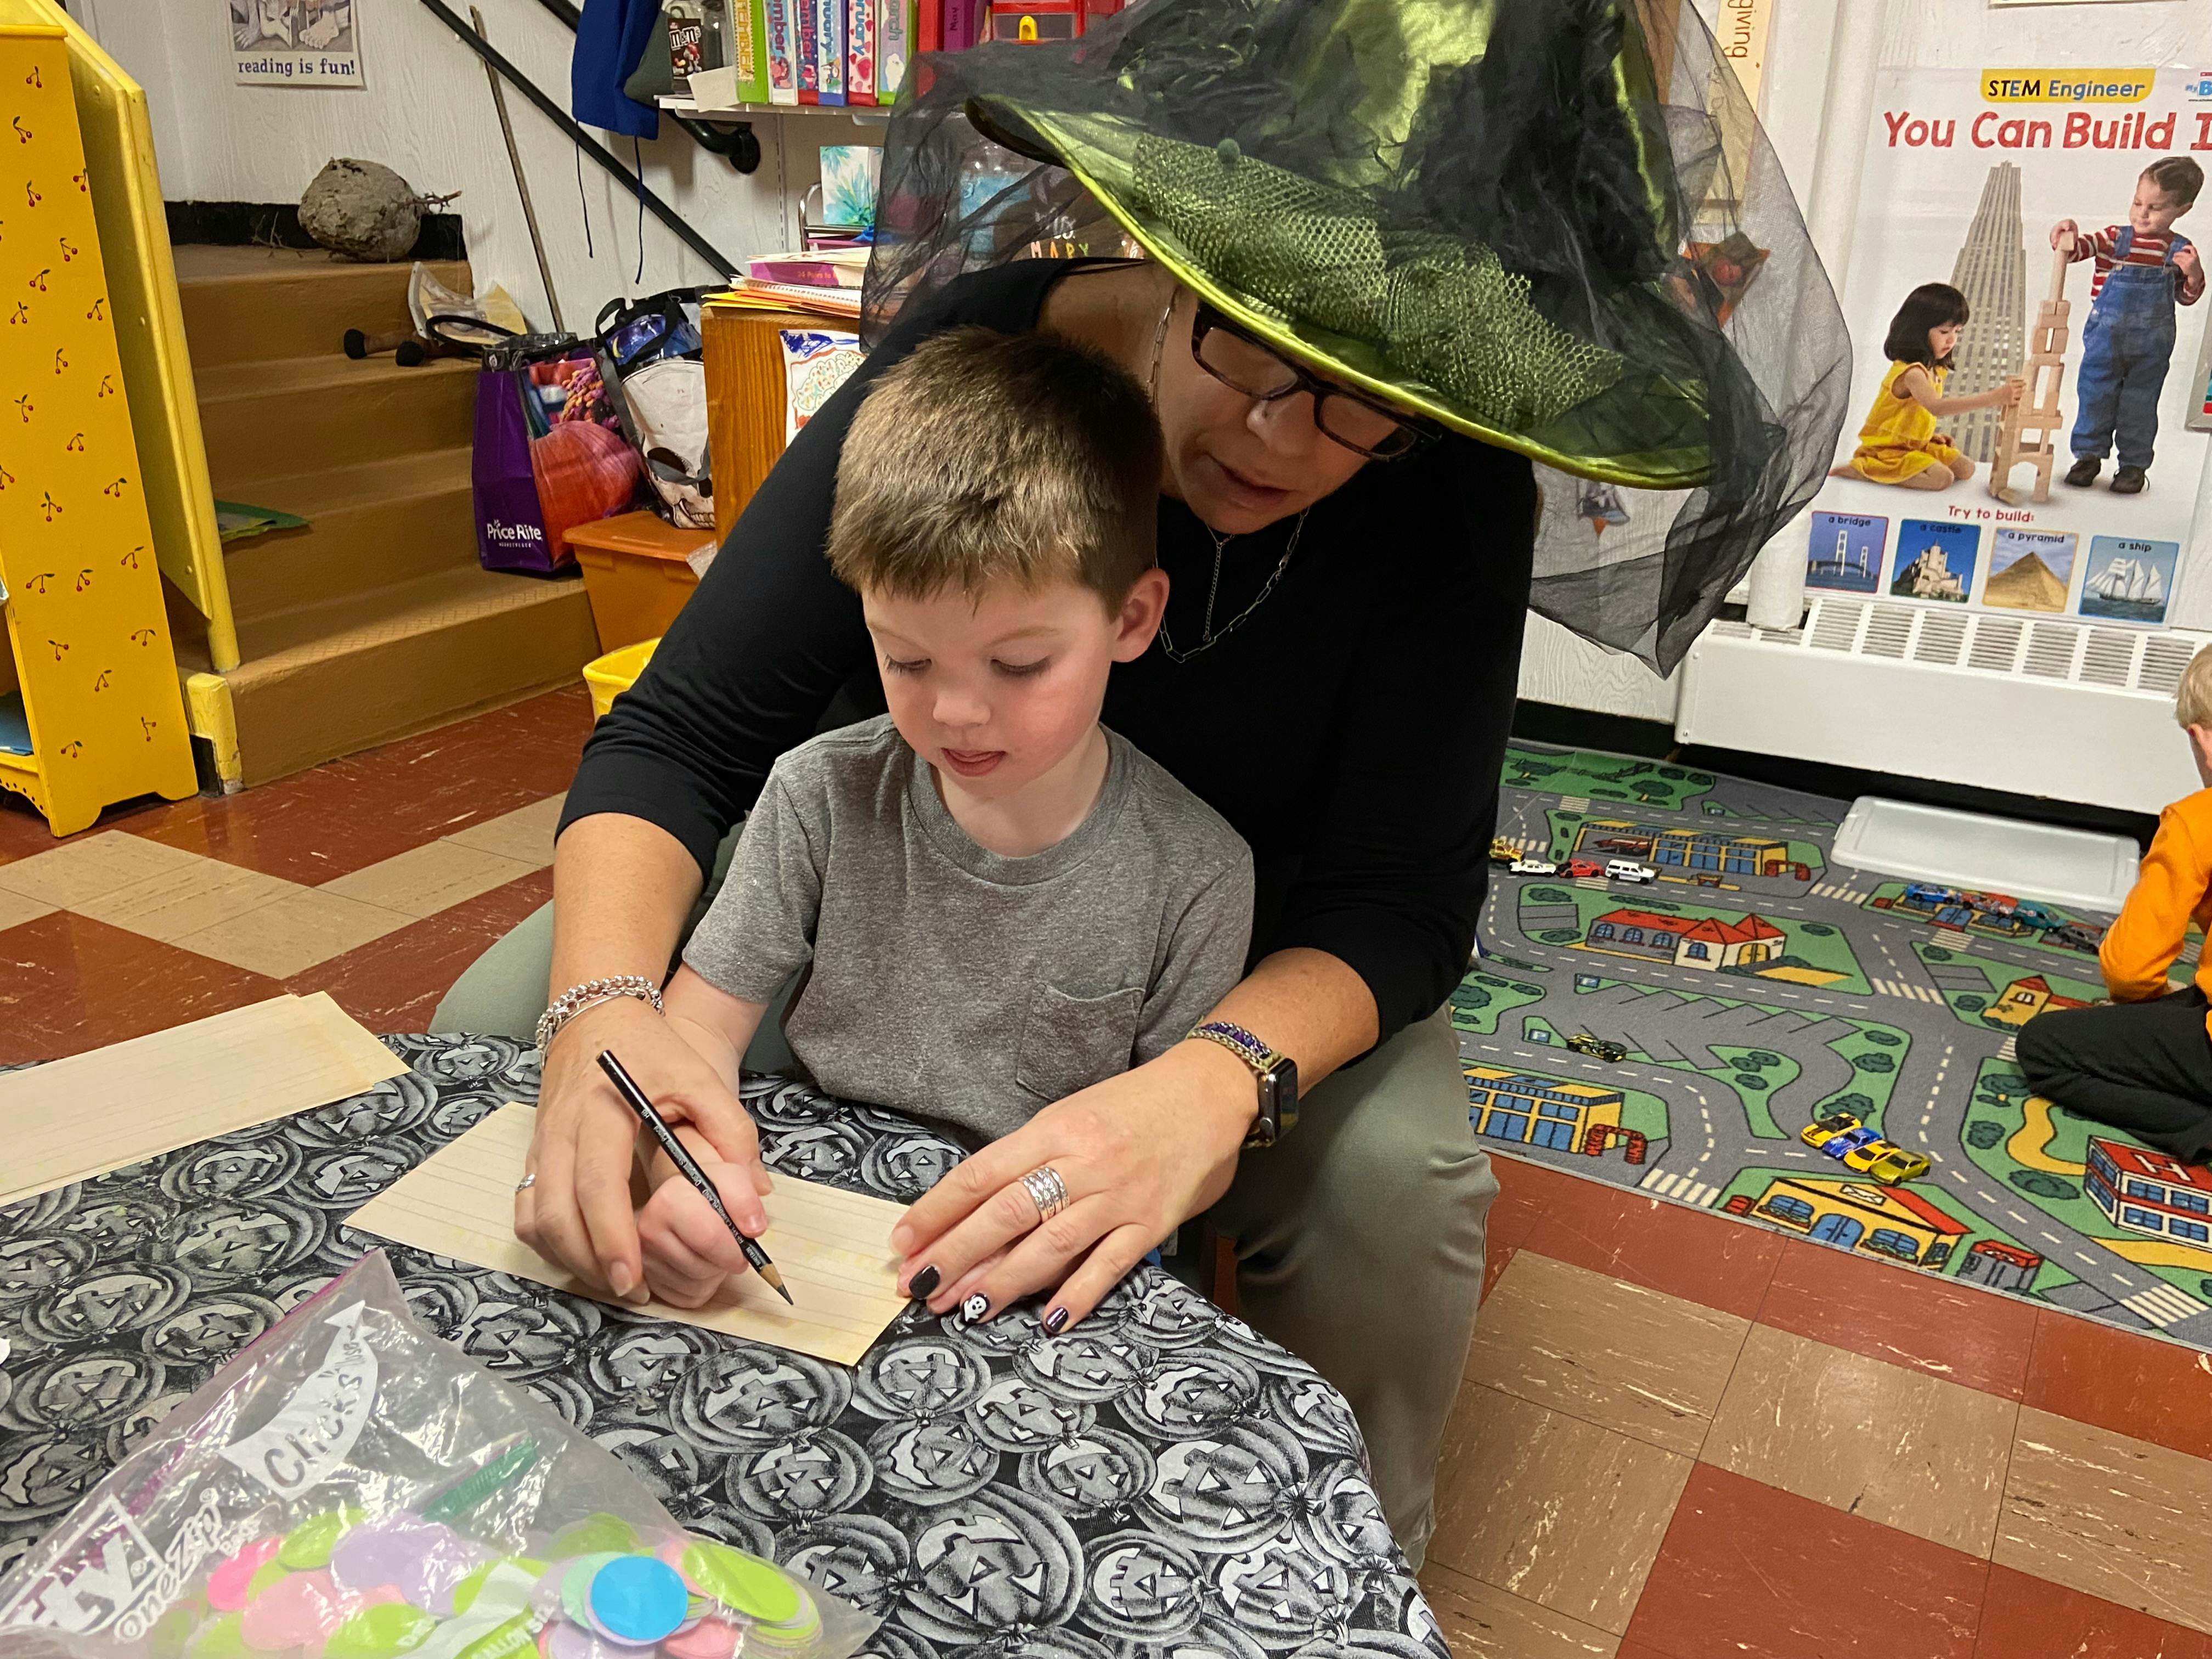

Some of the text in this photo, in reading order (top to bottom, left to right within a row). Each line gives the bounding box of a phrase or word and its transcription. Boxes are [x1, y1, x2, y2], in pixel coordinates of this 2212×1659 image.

[773, 0, 788, 54] mber
[852, 0, 865, 55] ruary
[238, 57, 355, 77] reading is fun!
[1988, 79, 2145, 100] STEM Engineer
[1883, 111, 1956, 148] You
[1971, 111, 2052, 149] Can
[2062, 111, 2177, 150] Build
[1838, 516, 1871, 527] bridge
[1948, 505, 2034, 522] Try to build:
[487, 519, 542, 541] Price Rite
[1930, 524, 1962, 533] castle
[2018, 533, 2064, 543] pyramid
[2129, 541, 2152, 552] ship
[1533, 1030, 1547, 1040] P
